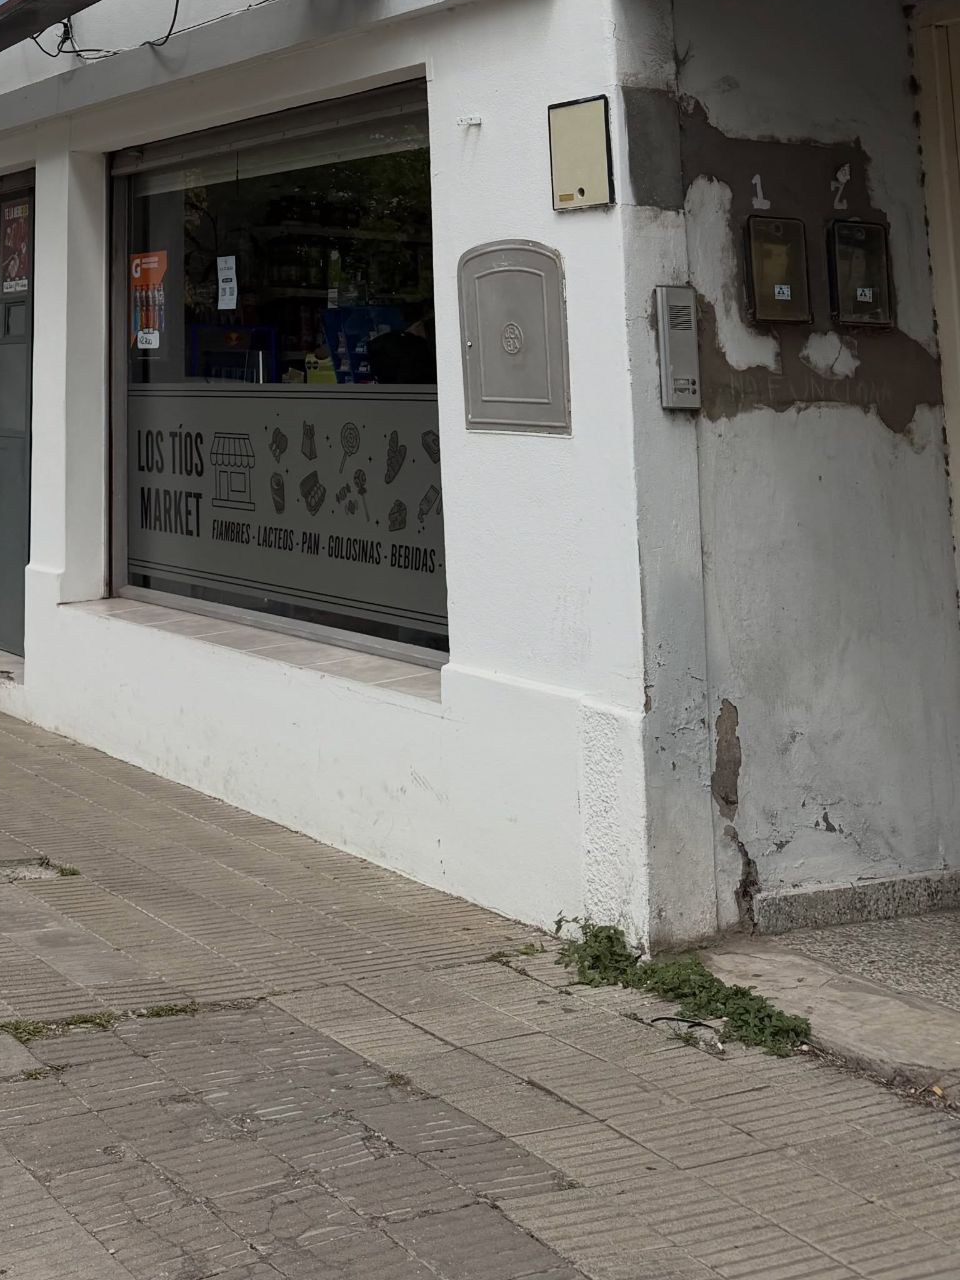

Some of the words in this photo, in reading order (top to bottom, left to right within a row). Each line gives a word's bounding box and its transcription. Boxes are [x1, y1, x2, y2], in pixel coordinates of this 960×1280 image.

[751, 174, 771, 209] 1
[137, 429, 164, 474] LOS
[169, 424, 204, 477] TÍOS
[140, 486, 203, 538] MARKET
[212, 519, 251, 545] FIAMBRES
[257, 526, 294, 552] LACTEOS
[301, 531, 321, 556] PAN
[328, 535, 382, 565] GOLOSINAS
[390, 544, 436, 573] BEBIDAS
